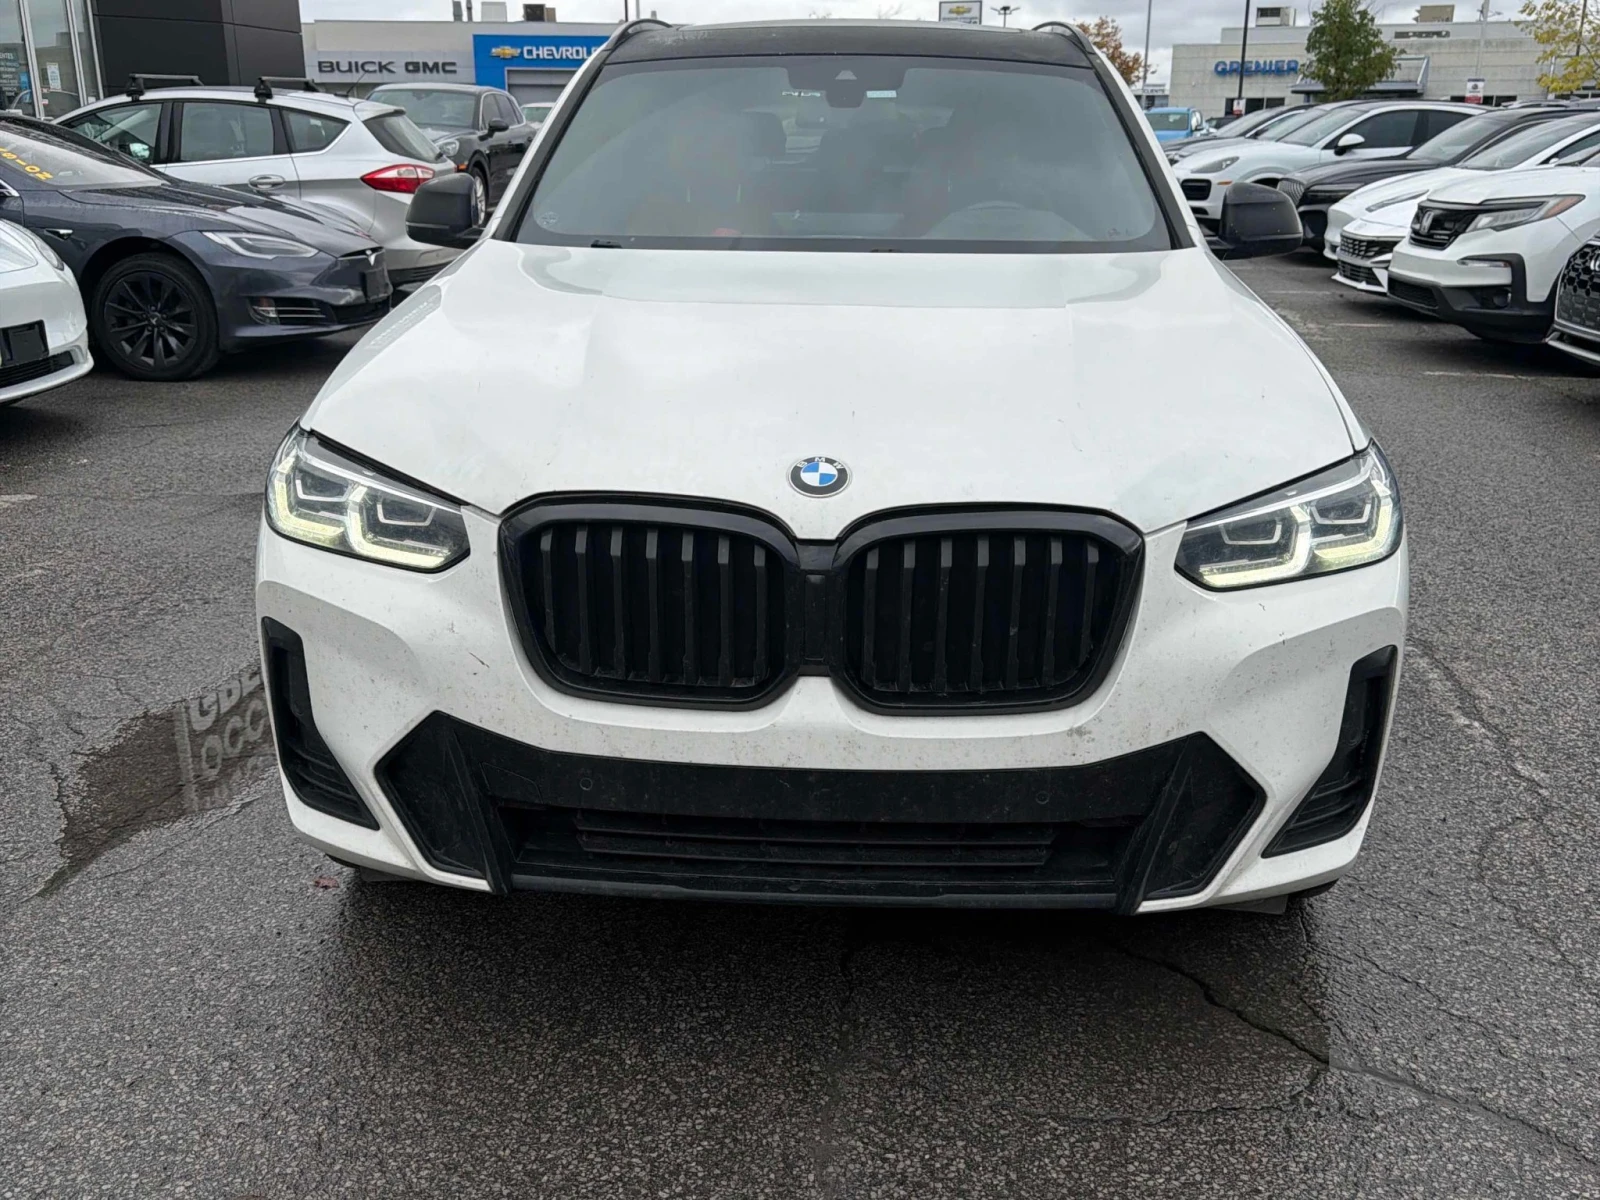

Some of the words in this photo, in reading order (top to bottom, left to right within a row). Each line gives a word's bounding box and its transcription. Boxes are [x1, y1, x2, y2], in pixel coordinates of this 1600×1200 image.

[317, 60, 396, 74] BUICK
[404, 60, 458, 74] GMC
[1214, 59, 1299, 76] GRENIER
